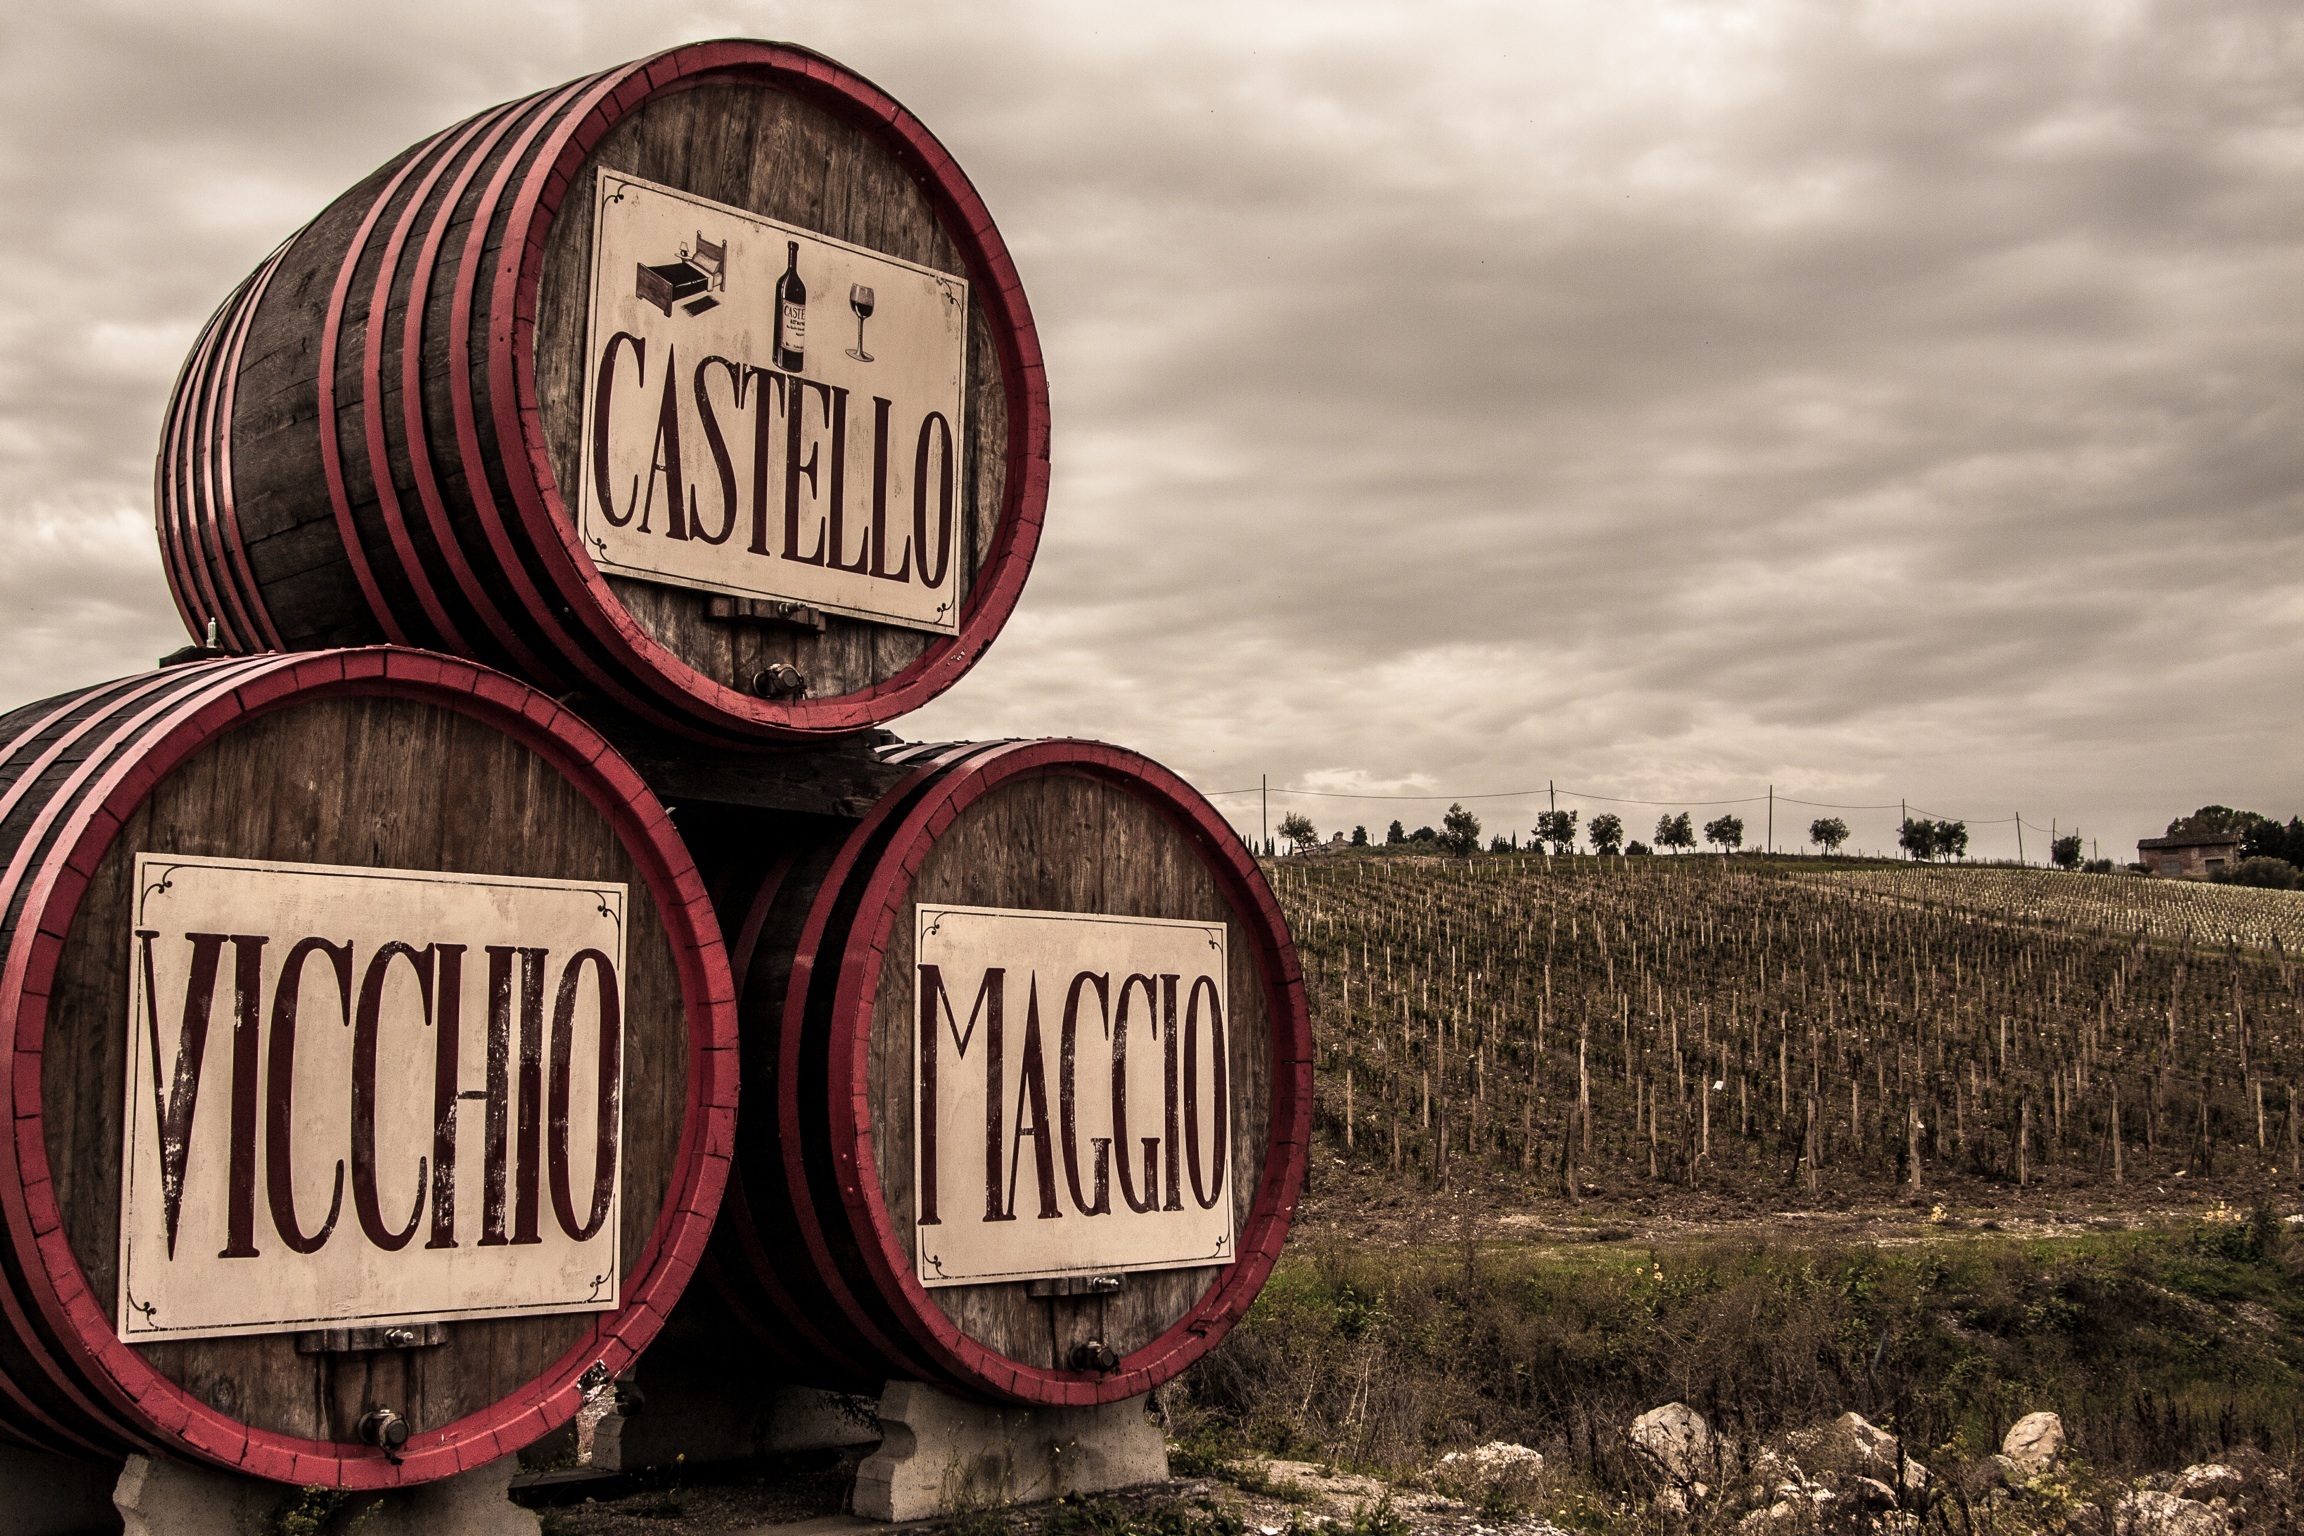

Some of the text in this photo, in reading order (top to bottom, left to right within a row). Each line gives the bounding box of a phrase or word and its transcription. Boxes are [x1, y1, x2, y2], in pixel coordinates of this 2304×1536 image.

[593, 331, 953, 589] CASTELLO
[135, 930, 621, 1261] VICCHIO
[917, 964, 1226, 1225] MAGGIO
